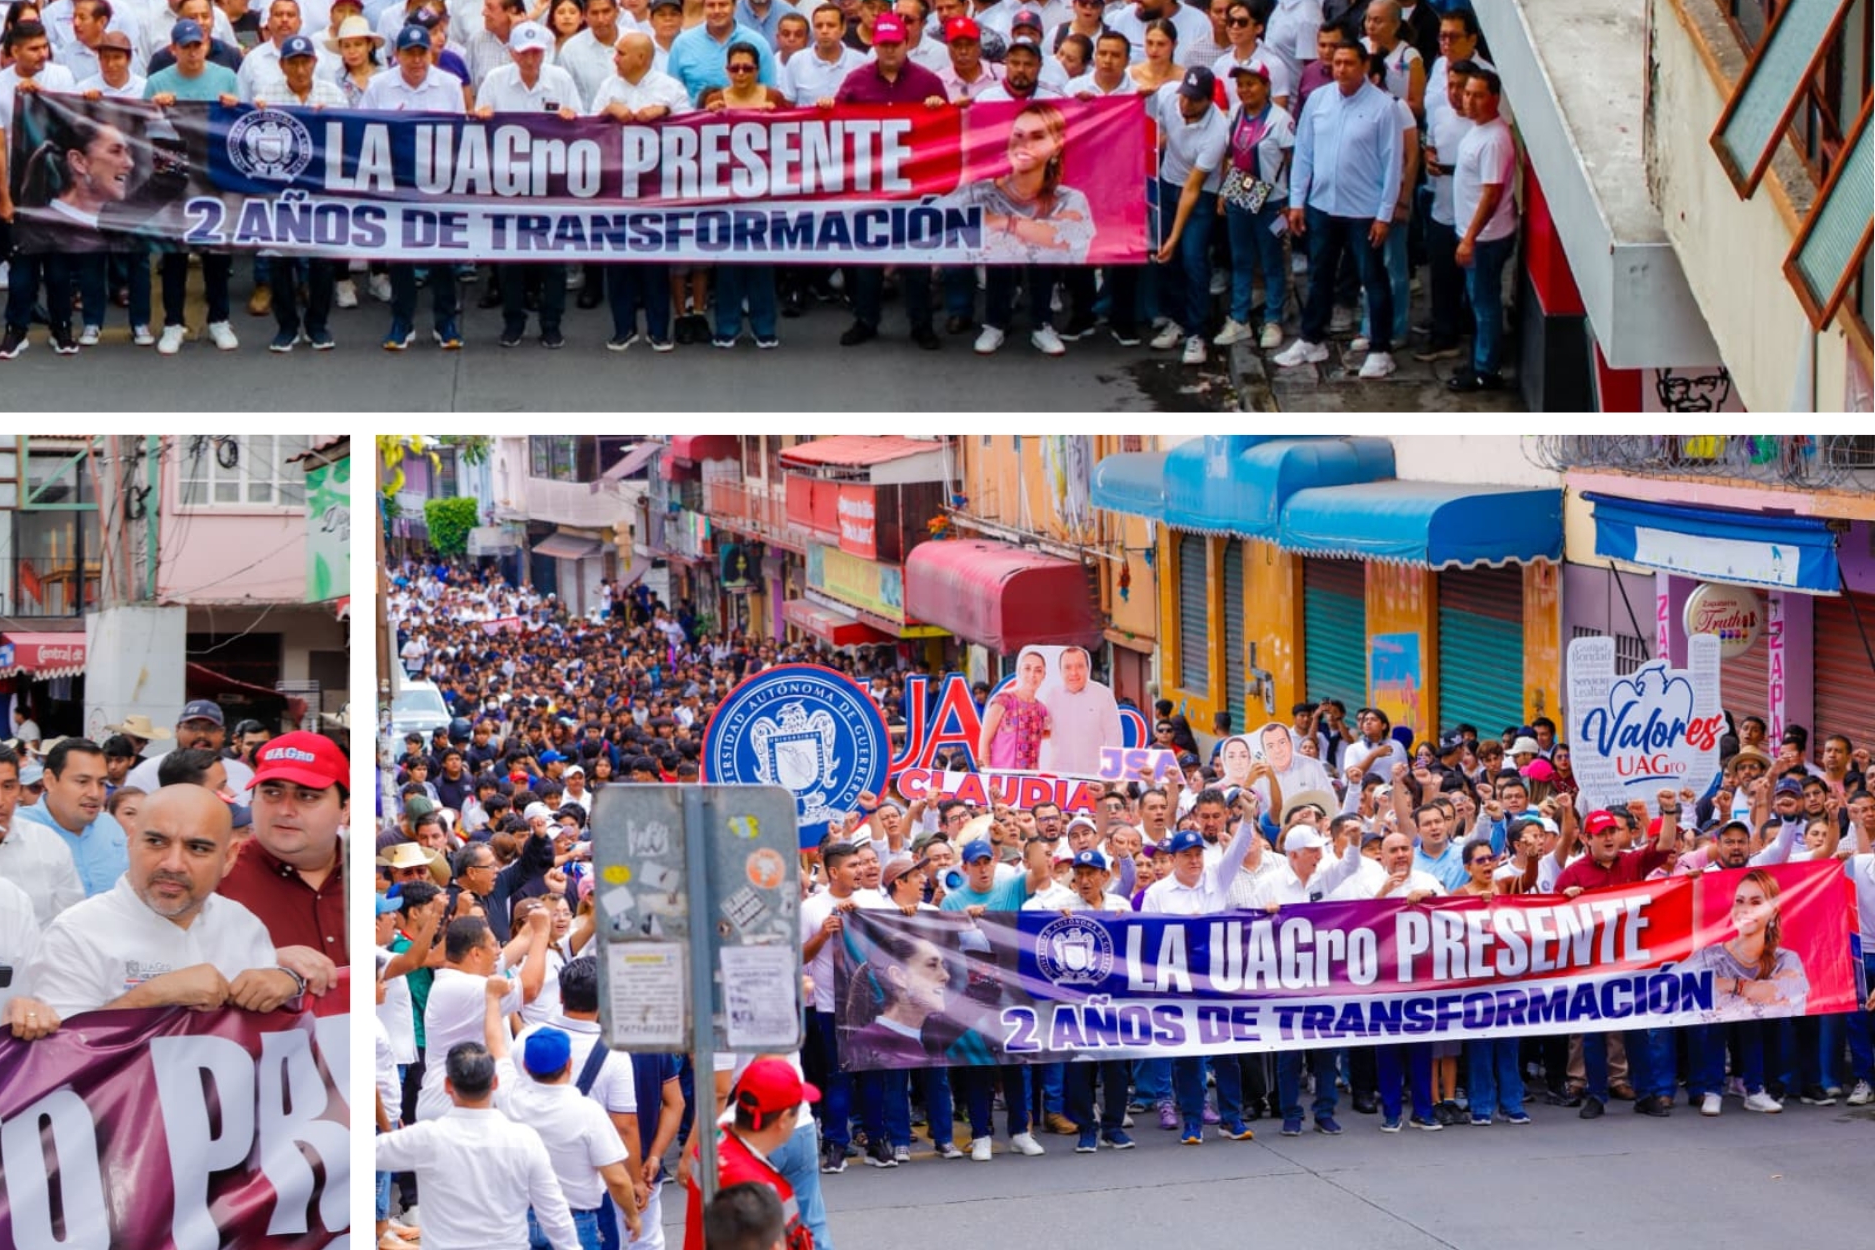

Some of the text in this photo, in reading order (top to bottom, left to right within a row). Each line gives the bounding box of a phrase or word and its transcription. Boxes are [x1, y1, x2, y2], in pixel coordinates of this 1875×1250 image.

[324, 121, 396, 194] LA
[415, 124, 601, 199] UAGro
[621, 118, 912, 200] PRESENTE
[183, 189, 983, 254] 2 AÑOS DE TRANSFORMACIÓN
[38, 646, 72, 662] Central
[748, 682, 835, 711] AUTÓNOMA
[839, 702, 857, 720] DE
[1581, 700, 1724, 757] Valores
[843, 725, 870, 803] GUERRERO
[1616, 754, 1686, 777] UAGro
[1126, 924, 1193, 992] LA
[1210, 917, 1377, 991] UAGro
[1396, 893, 1653, 984] PRESENTE
[1001, 964, 1714, 1052] 2 AÑOS DE TRANSFORMACIÓN
